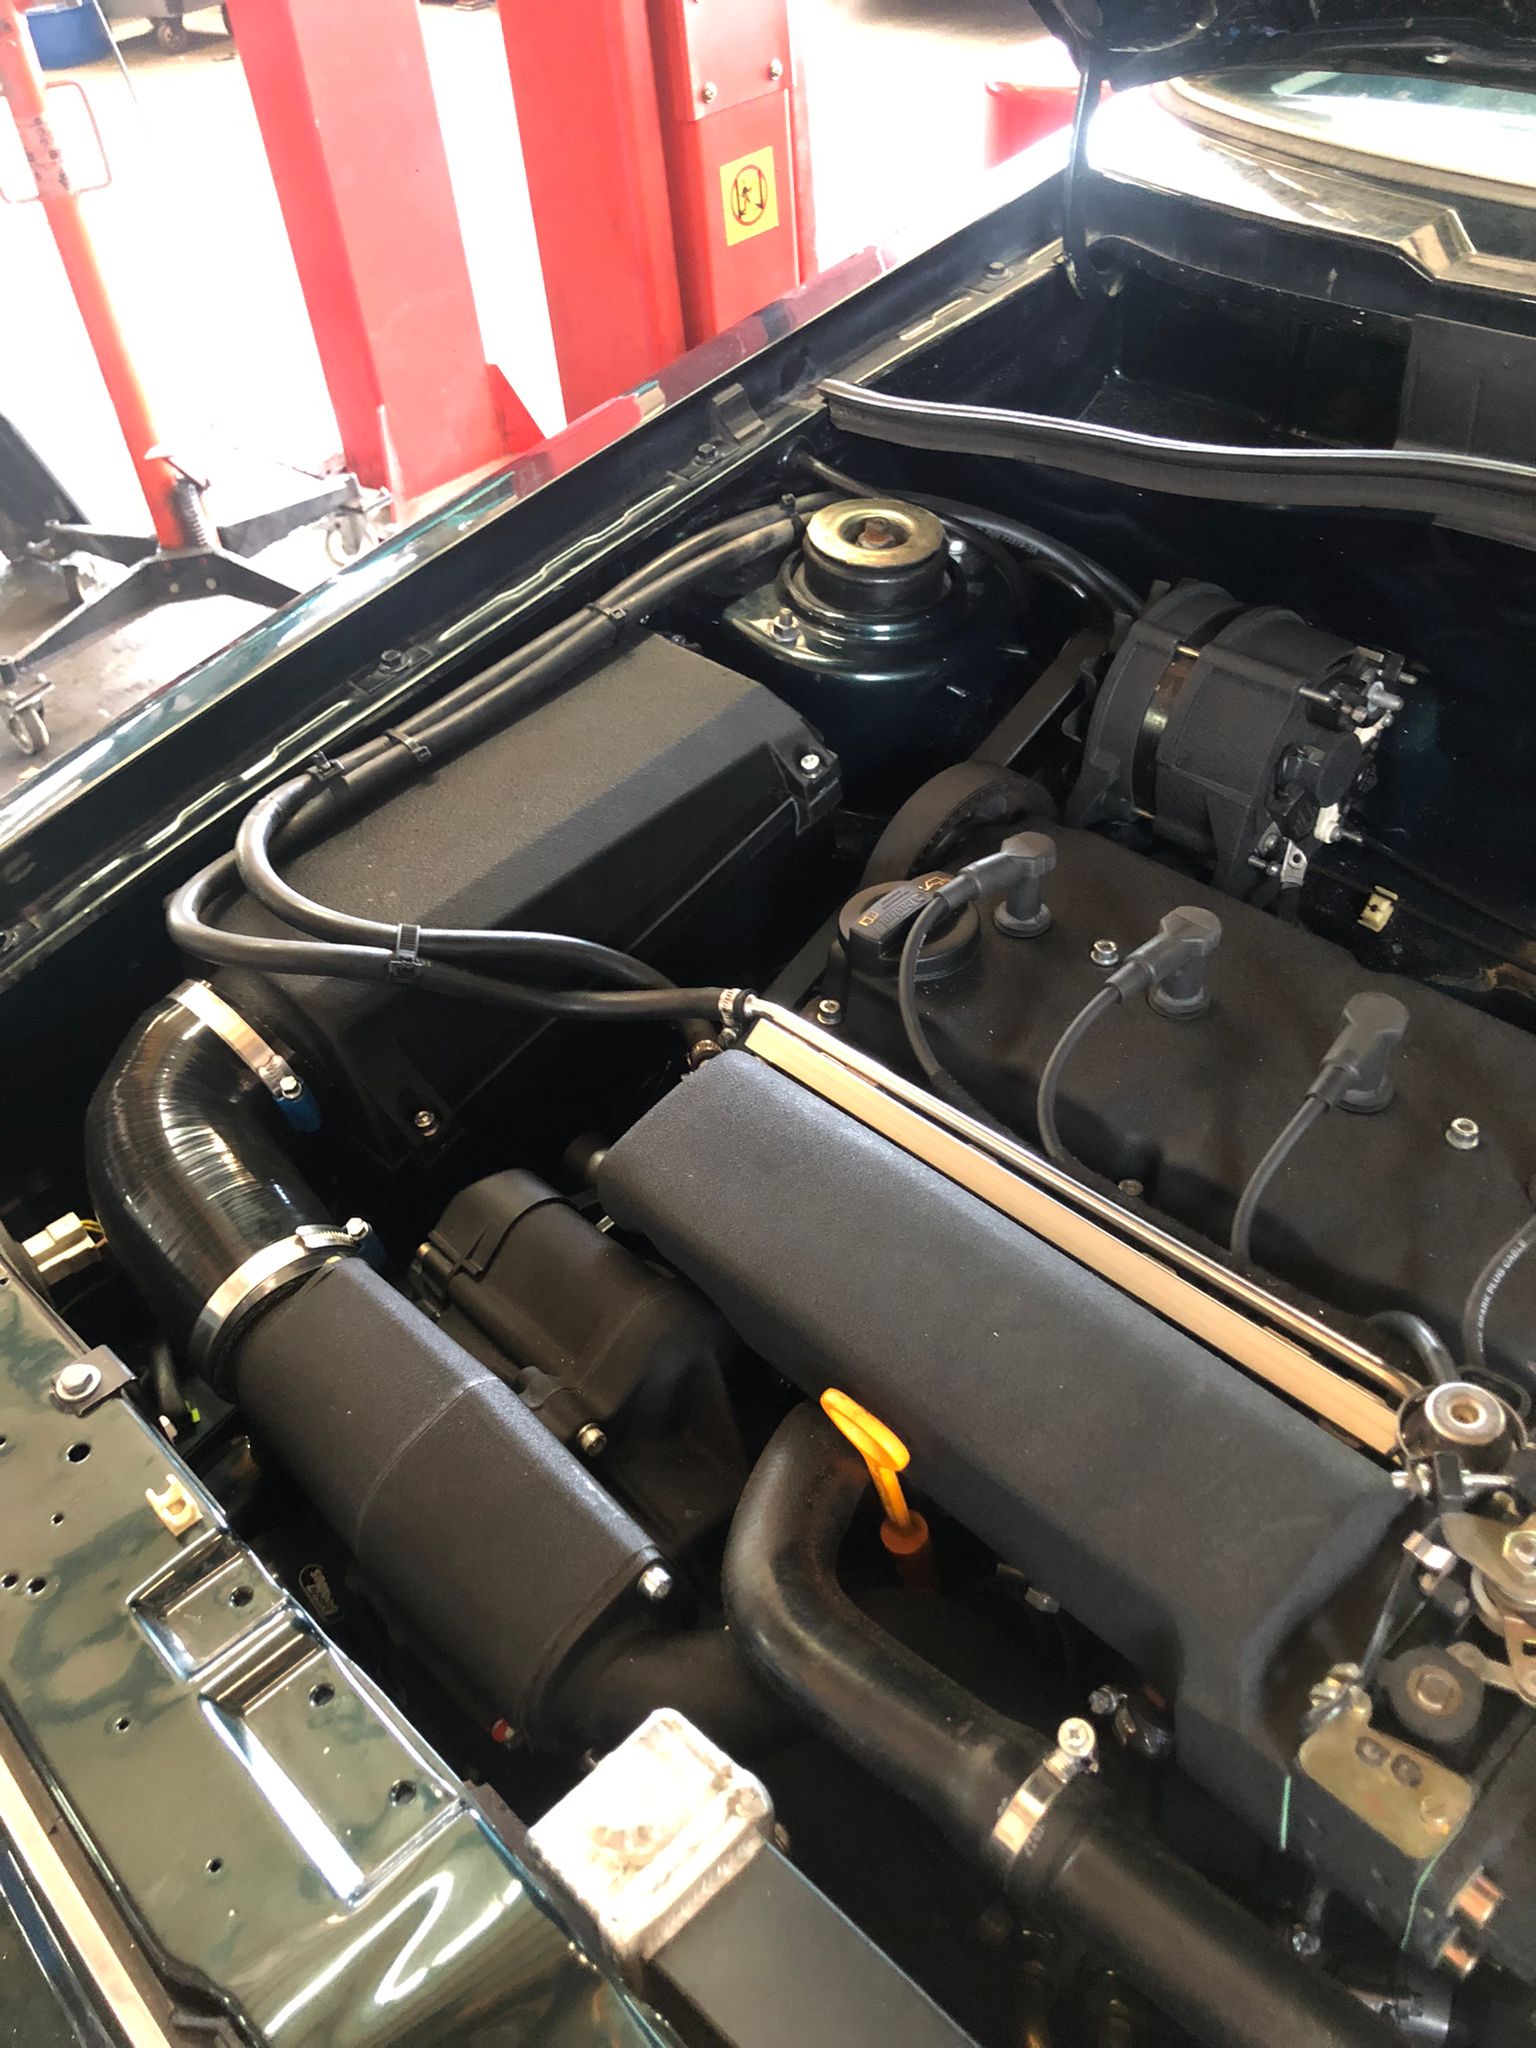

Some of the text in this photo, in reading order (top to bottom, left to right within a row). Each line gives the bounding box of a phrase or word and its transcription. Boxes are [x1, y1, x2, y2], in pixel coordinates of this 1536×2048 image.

[1477, 1294, 1492, 1329] SPARK
[1486, 1269, 1506, 1295] PLUG
[1503, 1238, 1528, 1269] CABLE
